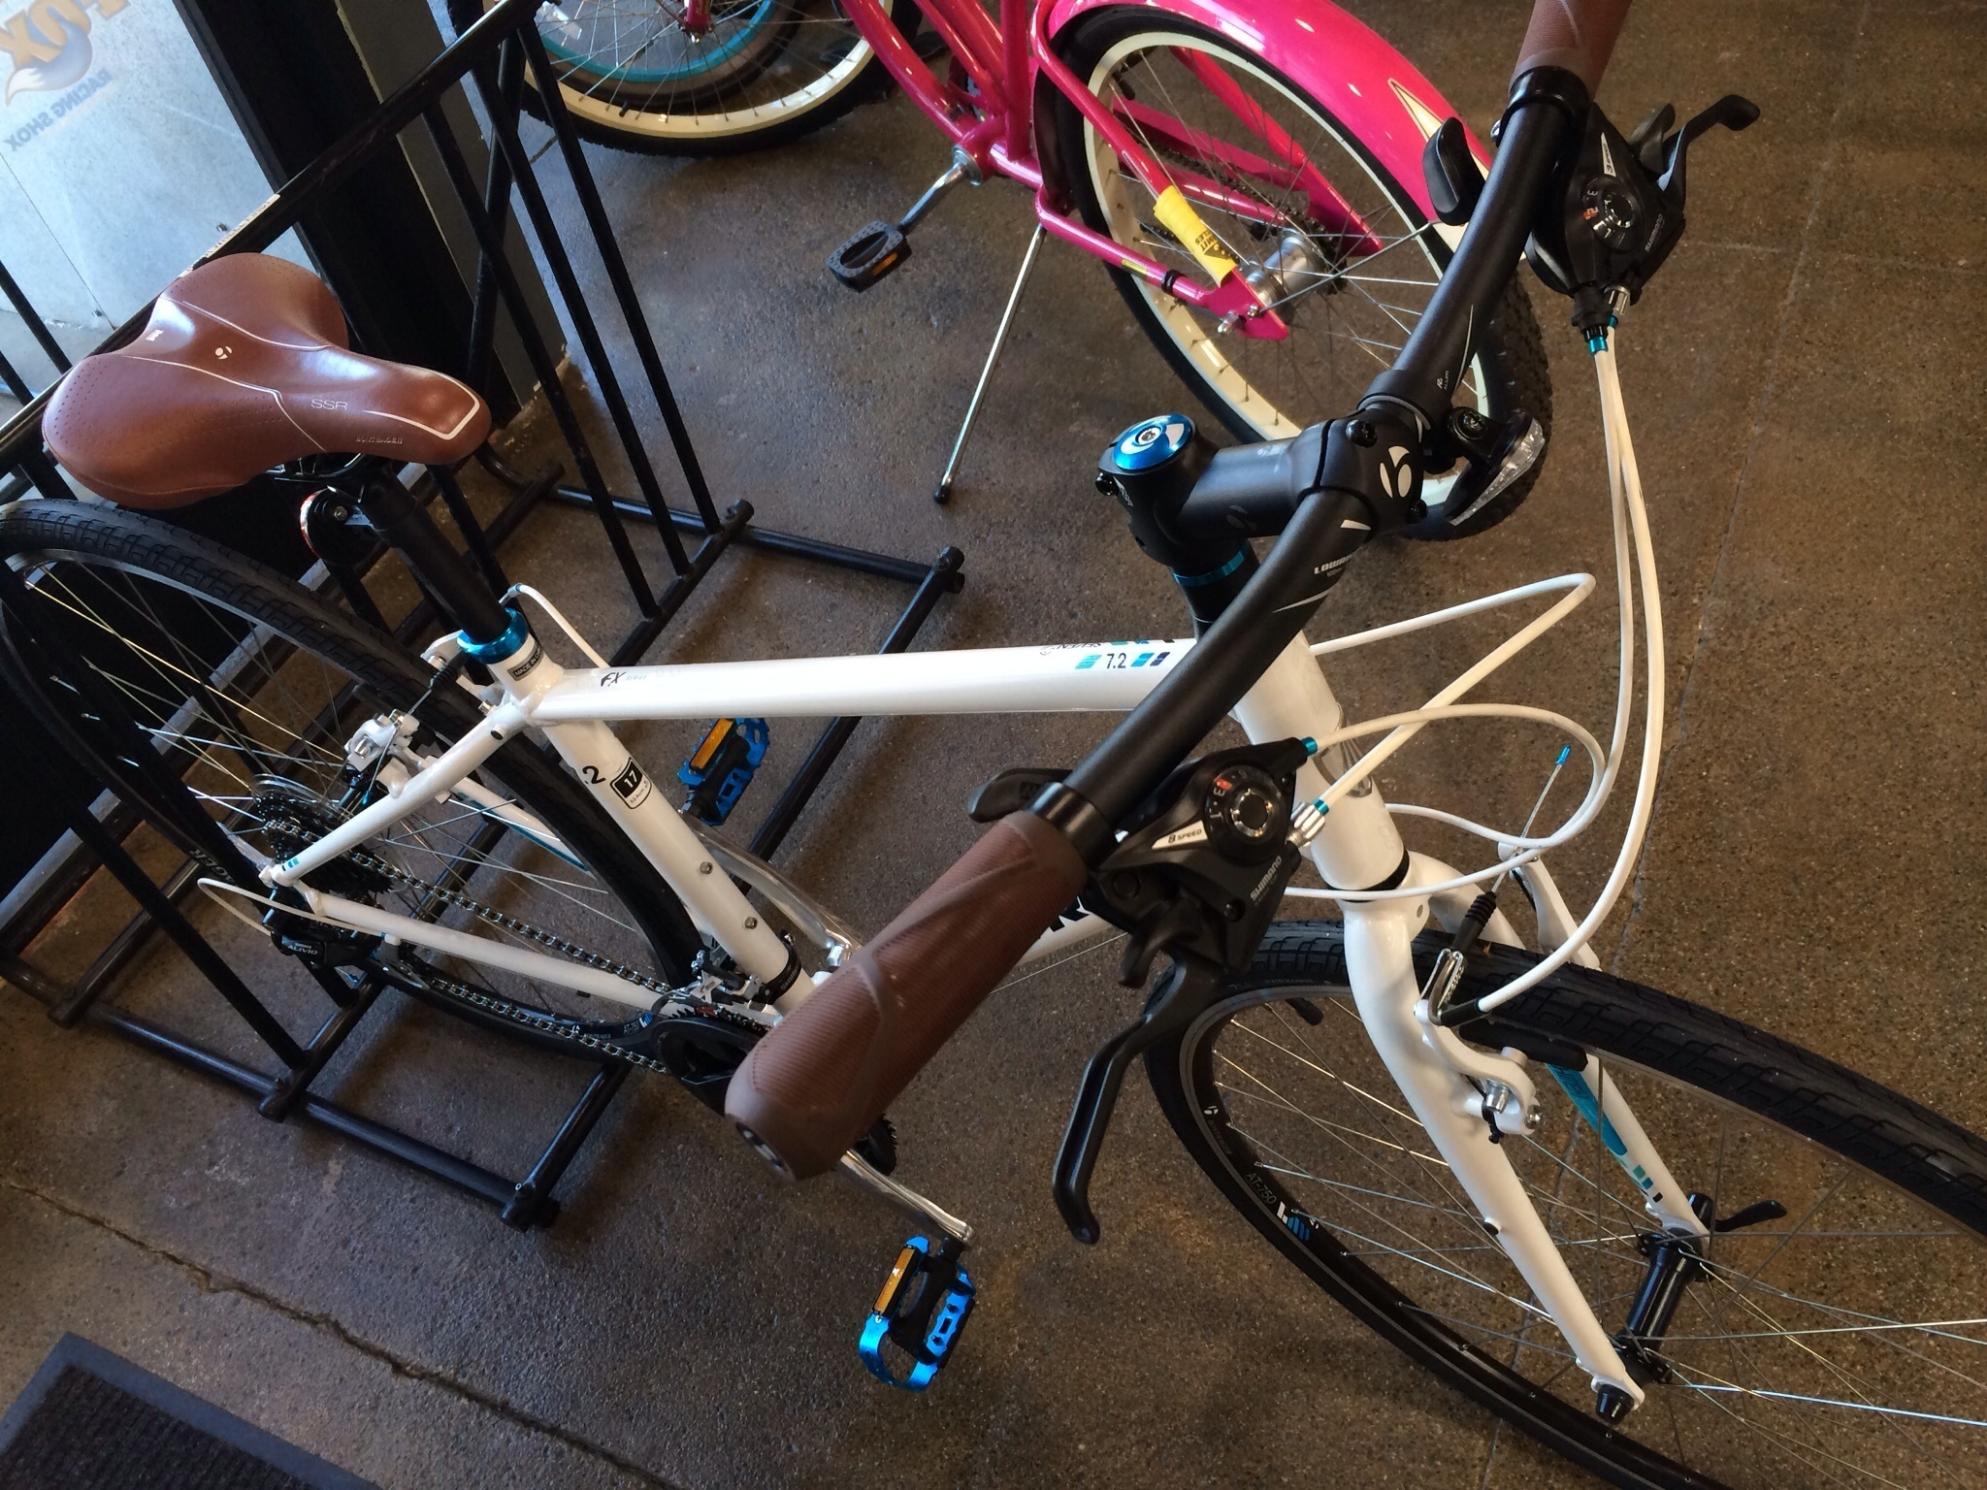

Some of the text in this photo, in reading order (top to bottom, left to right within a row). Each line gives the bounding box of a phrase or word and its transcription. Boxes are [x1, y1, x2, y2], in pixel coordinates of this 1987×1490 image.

[311, 398, 348, 411] SSR
[1106, 653, 1127, 669] 7.2
[600, 671, 627, 688] FX
[624, 769, 638, 788] 17
[1177, 828, 1203, 841] SPEED
[1250, 855, 1282, 900] SHIMANO
[287, 944, 319, 956] ALIVIO
[1244, 1172, 1278, 1205] AT-750
